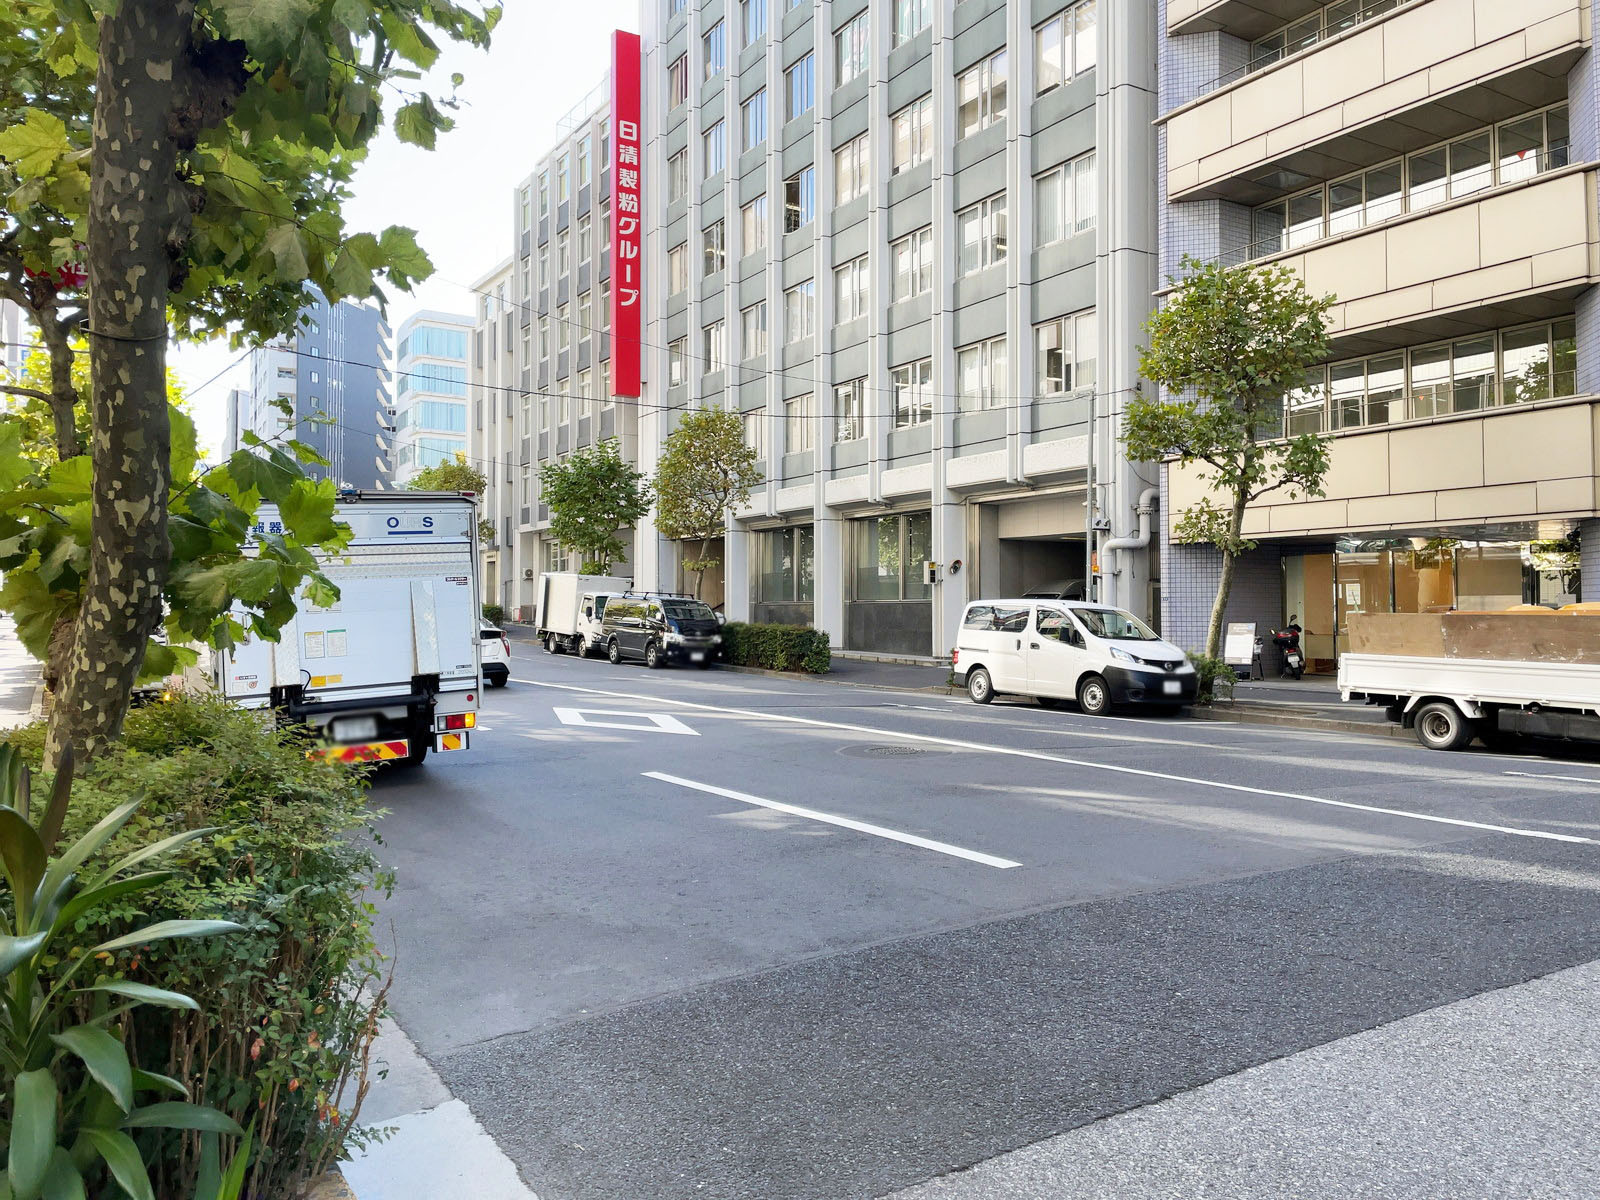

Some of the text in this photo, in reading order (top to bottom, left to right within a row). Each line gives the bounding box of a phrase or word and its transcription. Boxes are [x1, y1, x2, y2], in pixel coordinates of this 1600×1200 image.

[618, 120, 639, 306] 日清製粉グループ
